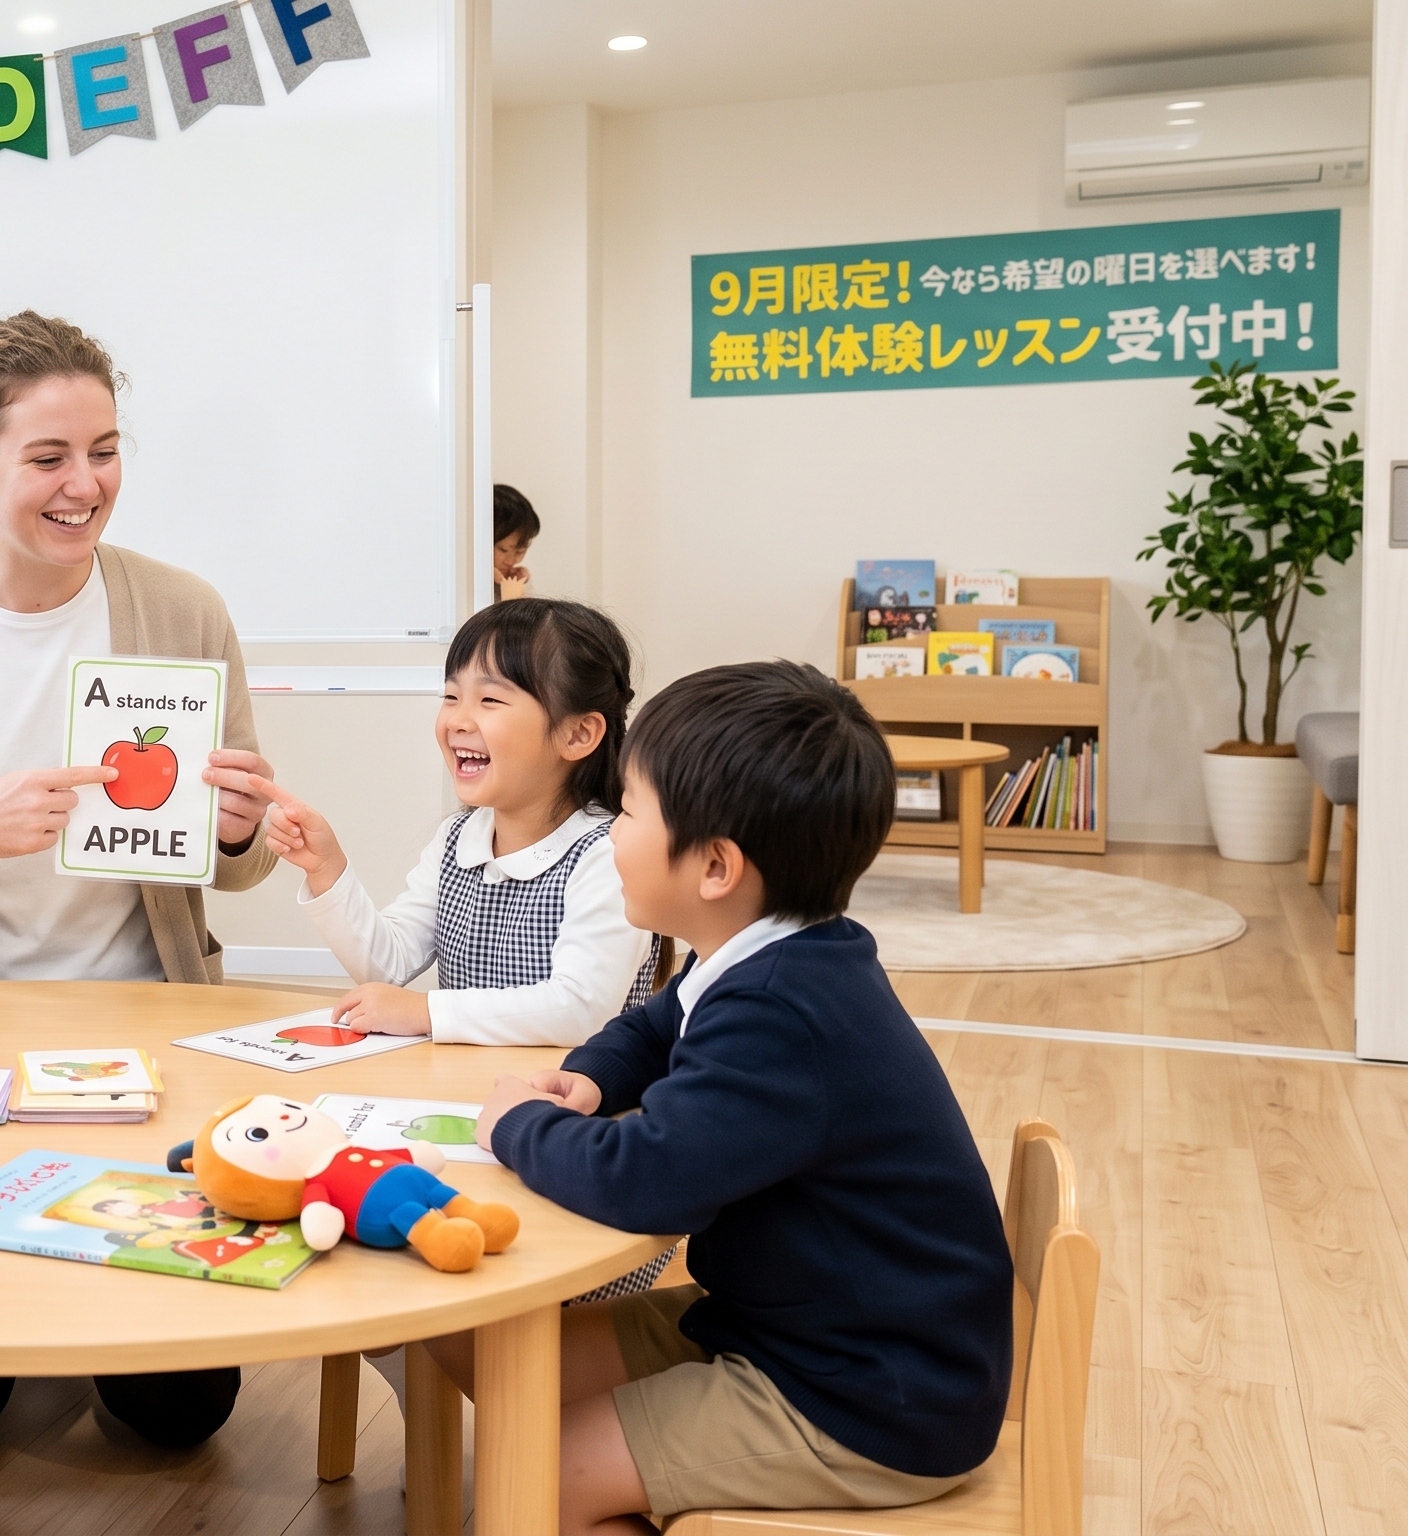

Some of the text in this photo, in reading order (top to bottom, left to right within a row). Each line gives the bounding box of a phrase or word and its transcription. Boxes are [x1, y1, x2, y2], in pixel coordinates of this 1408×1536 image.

[71, 45, 139, 131] E
[173, 13, 232, 104] F
[709, 241, 1316, 317] 9月限定! 今なら希望の曜日を選べます!
[709, 299, 1315, 383] 無料体験レッスン受付中!
[84, 677, 208, 712] A stands for
[83, 825, 188, 858] APPLE
[284, 1053, 316, 1062] A
